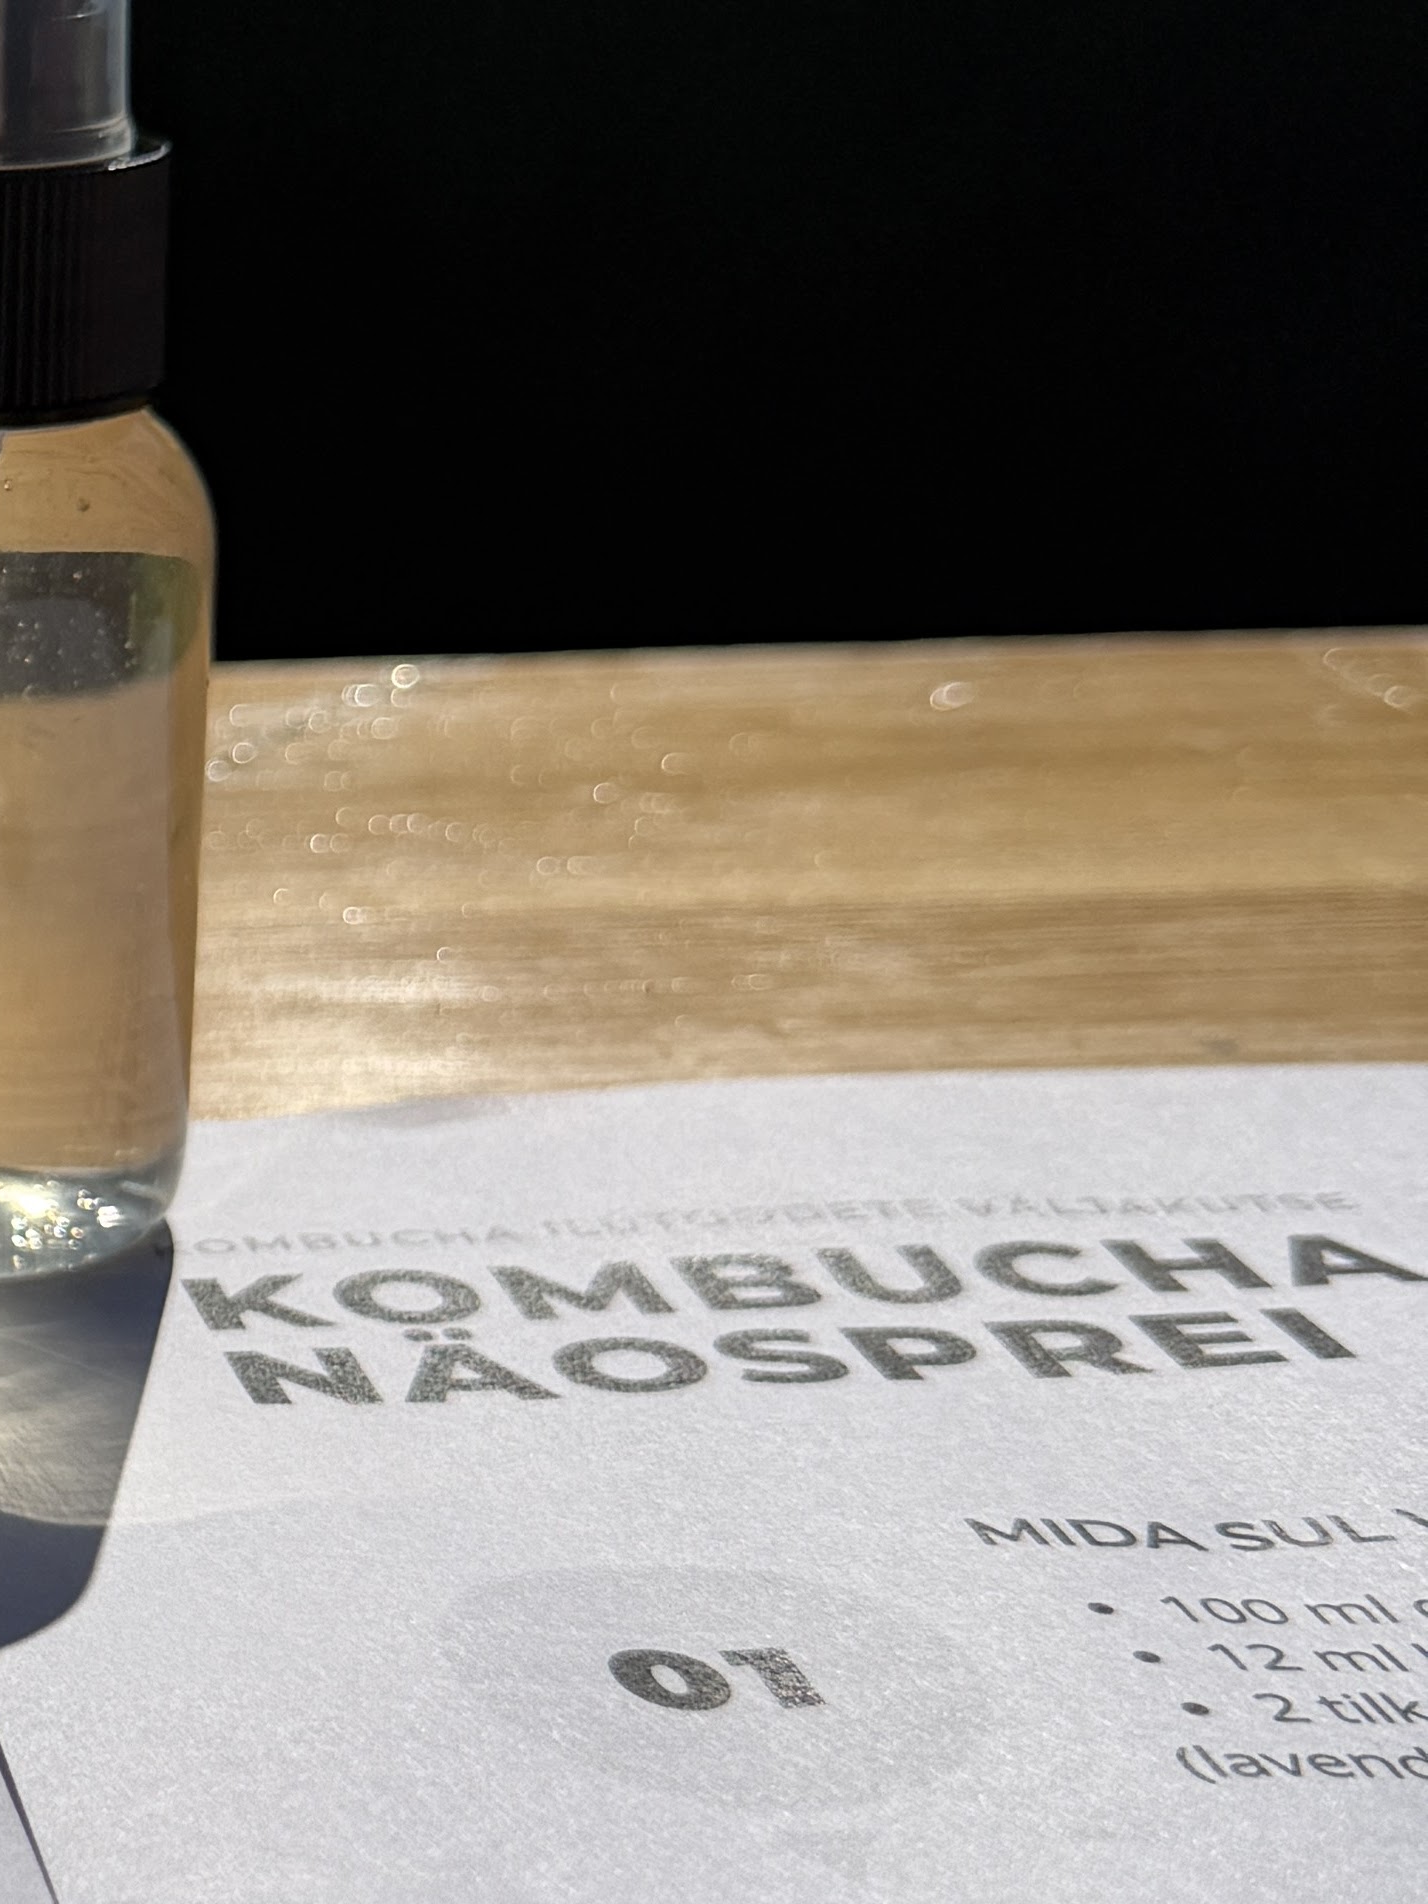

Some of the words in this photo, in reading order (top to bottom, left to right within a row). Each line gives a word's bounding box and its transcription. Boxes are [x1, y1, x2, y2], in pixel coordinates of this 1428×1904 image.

[181, 1233, 1428, 1332] KOMBUCHA
[225, 1307, 1358, 1405] NÄOSPREI
[964, 1517, 1210, 1552] MIDA
[1214, 1514, 1398, 1552] SUL
[1160, 1595, 1290, 1625] 100
[1304, 1593, 1401, 1625] ml
[1207, 1643, 1306, 1672] 12
[1314, 1643, 1411, 1672] ml
[607, 1646, 827, 1711] 01
[1252, 1692, 1313, 1724] 2
